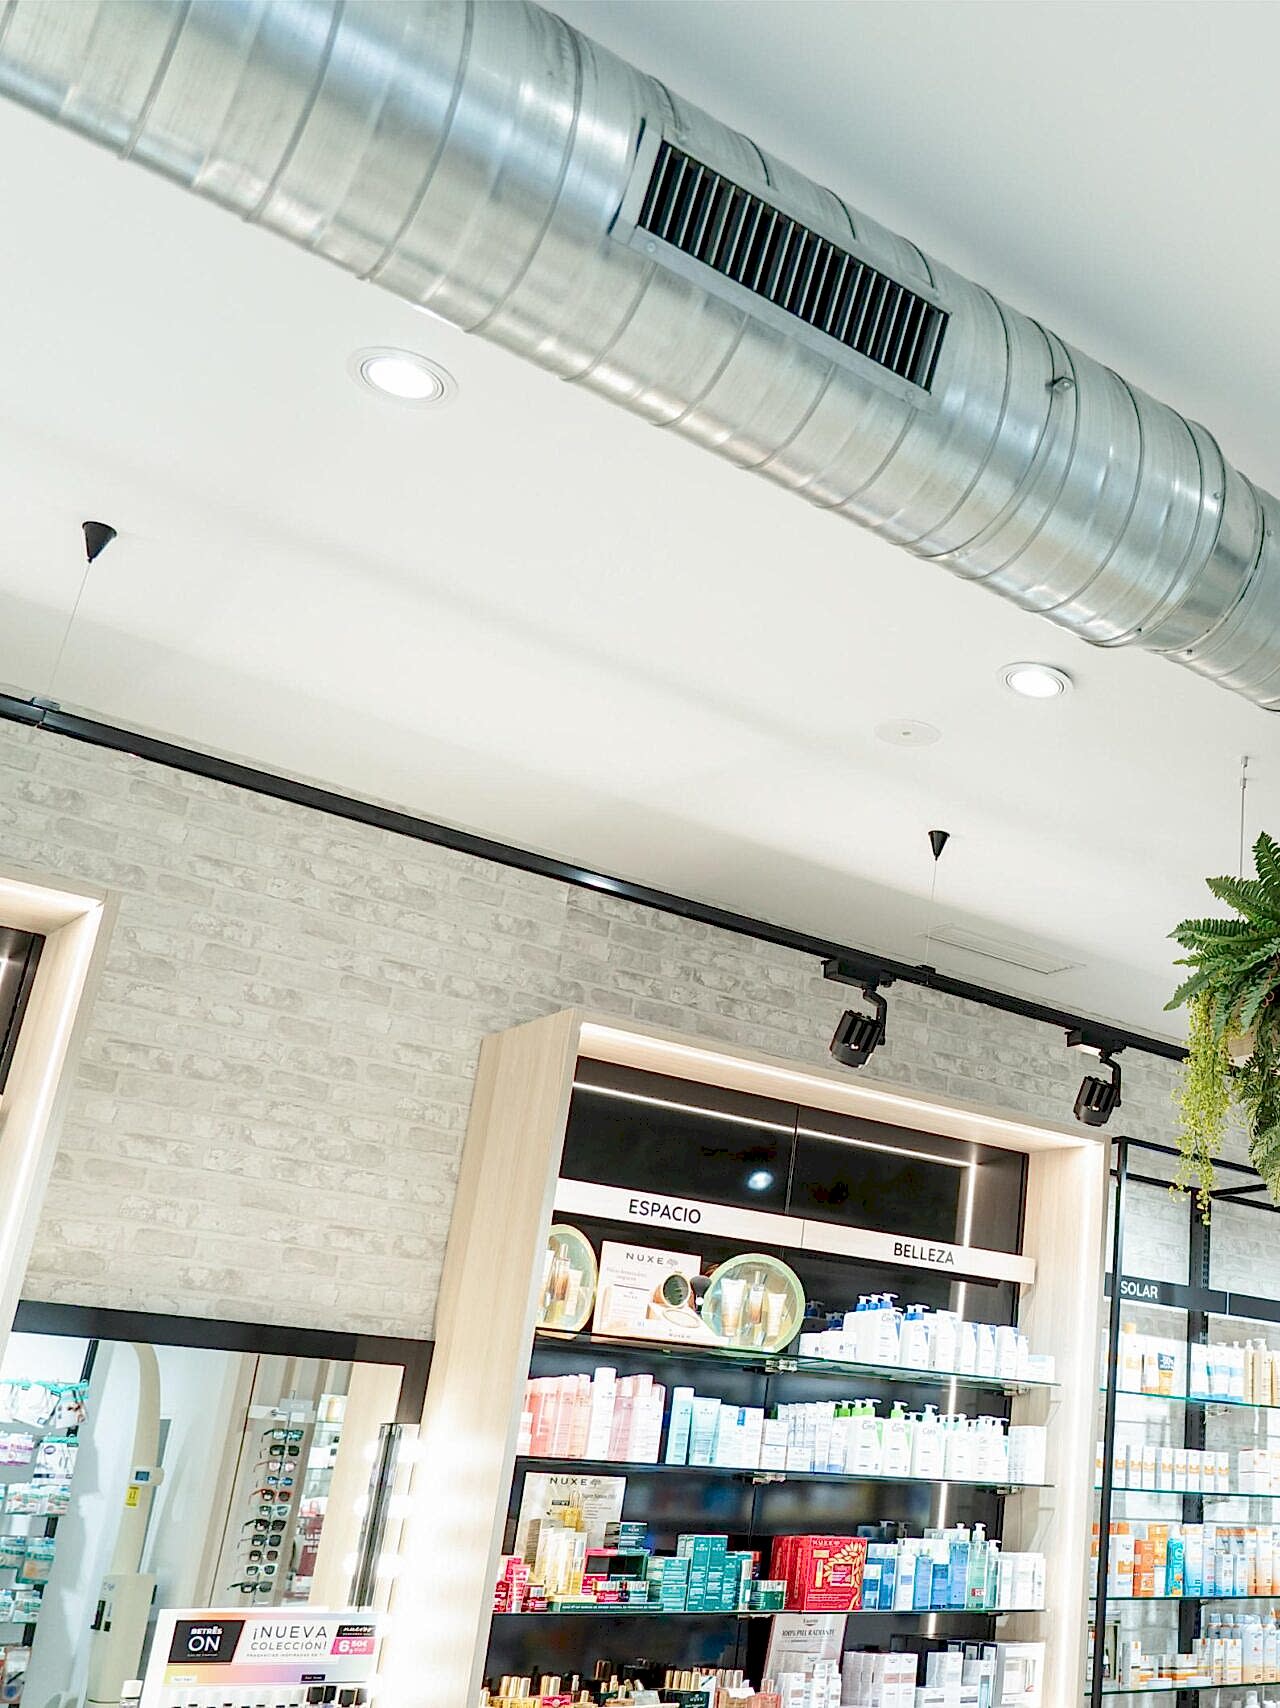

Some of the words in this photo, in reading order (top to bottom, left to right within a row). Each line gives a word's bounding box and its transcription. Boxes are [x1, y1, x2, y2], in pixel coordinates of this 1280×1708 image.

[629, 1199, 701, 1224] ESPACIO
[894, 1242, 954, 1265] BELLEZA
[626, 1252, 664, 1265] NUXE
[1120, 1281, 1158, 1299] SOLAR
[550, 1476, 587, 1486] NUXE
[253, 1626, 327, 1640] ¡NUEVA
[188, 1636, 220, 1651] ON
[251, 1641, 327, 1650] COLECCIÓN!
